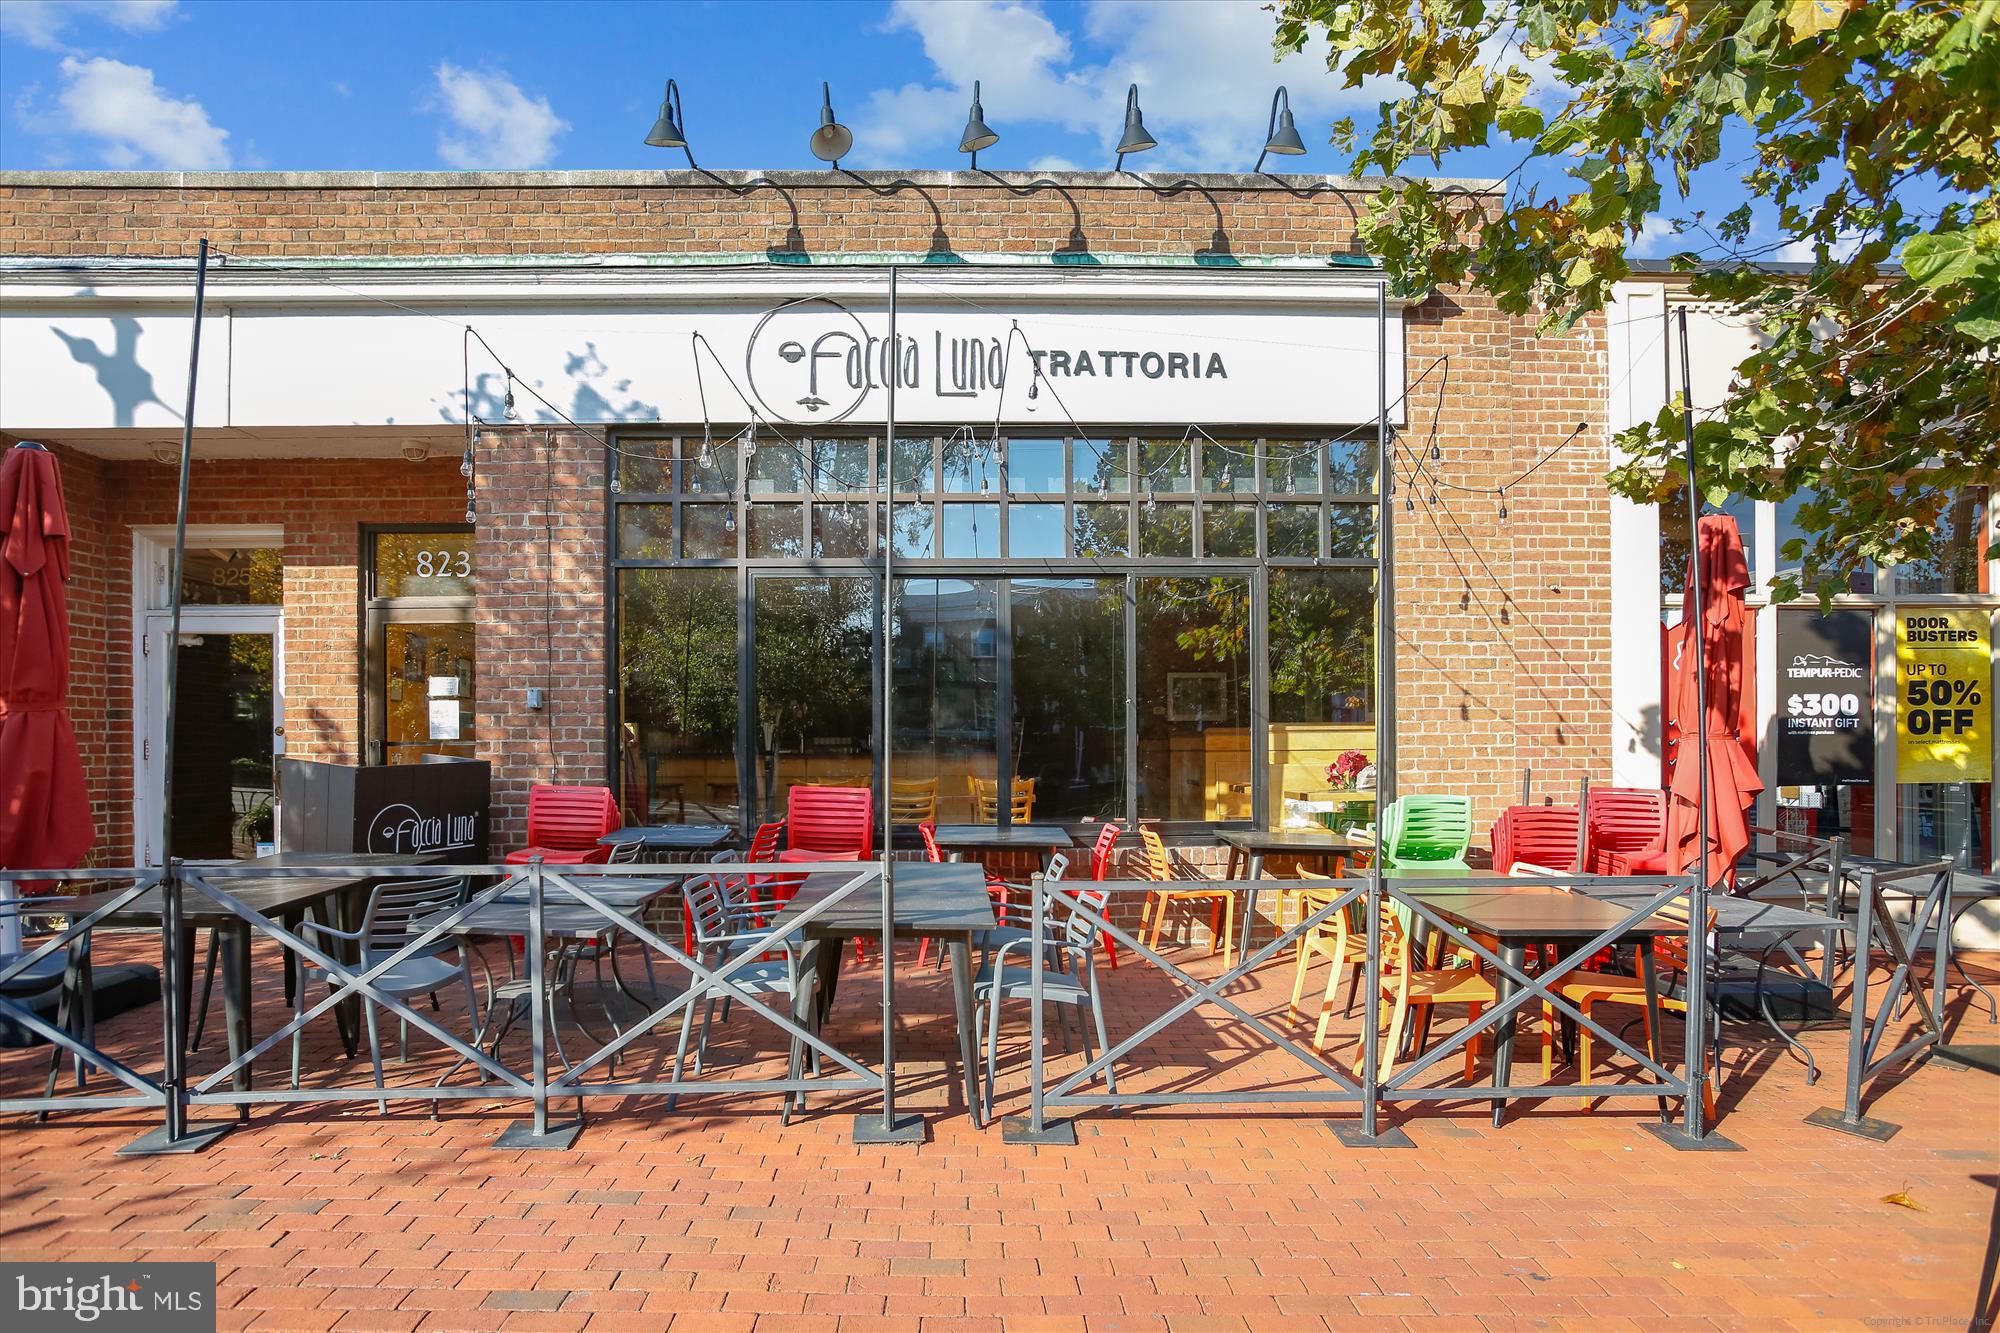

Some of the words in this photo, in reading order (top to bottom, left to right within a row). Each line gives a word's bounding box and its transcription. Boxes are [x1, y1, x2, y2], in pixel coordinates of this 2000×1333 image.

[935, 330, 1004, 397] Luna
[1026, 350, 1228, 379] TRATTORIA
[416, 550, 471, 578] 823
[212, 567, 252, 586] 825
[1906, 617, 1949, 629] DOOR
[1906, 630, 1978, 642] BUSTERS
[1787, 667, 1863, 679] TEMPUR-PEDIC
[1906, 664, 1926, 676] UP
[1928, 664, 1947, 676] TO
[1907, 680, 1982, 706] 50%
[1787, 693, 1859, 717] $300
[1787, 718, 1834, 728] INSTANT
[1834, 718, 1860, 728] GIFT
[1907, 709, 1974, 736] OFF
[396, 816, 441, 854] Faccia
[446, 813, 475, 847] Luna
